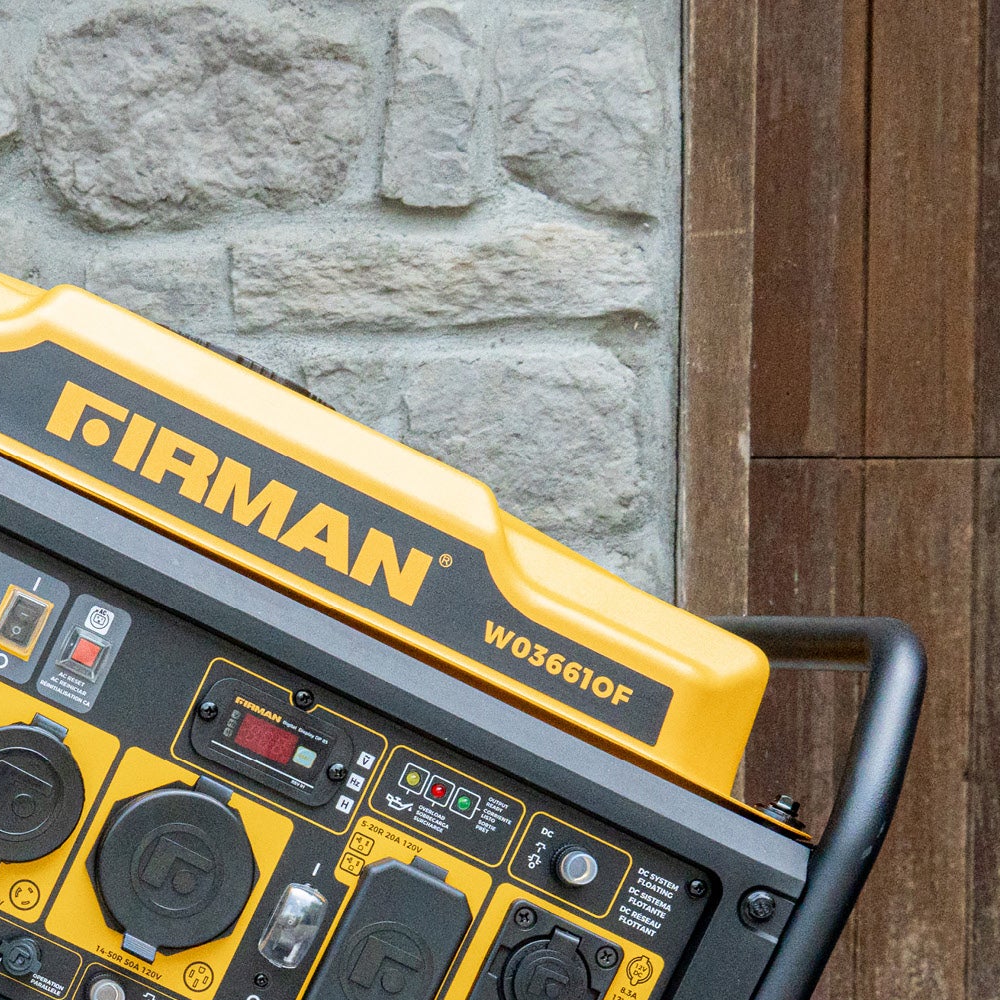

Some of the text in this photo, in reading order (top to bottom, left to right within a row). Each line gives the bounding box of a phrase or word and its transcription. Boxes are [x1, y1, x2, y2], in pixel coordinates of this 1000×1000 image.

[45, 380, 434, 607] FIRMAN
[50, 676, 59, 684] AC
[58, 671, 86, 687] AC RESET
[234, 696, 282, 724] FIRMAN
[350, 777, 360, 787] Hz
[341, 800, 349, 809] H
[486, 802, 503, 813] READY
[488, 797, 509, 809] OUTPUT
[415, 810, 449, 830] SOBRECARGA
[418, 804, 446, 821] OVERLOAD
[481, 814, 496, 824] LISTO
[483, 808, 513, 826] CORRIENTE
[413, 816, 444, 833] SURCHARGE
[540, 827, 554, 838] DC
[360, 820, 422, 854] 5-20R 20A 120V
[638, 867, 679, 892] DC SYSTEM
[637, 878, 674, 899] FLOATING
[628, 886, 672, 912] DC SISTEMA
[628, 896, 667, 919] FLOTANTE
[618, 914, 657, 937] FLOTTANT
[619, 905, 662, 930] DC RÉSEAU
[95, 945, 163, 981] 14-50R 50A 120V
[635, 963, 647, 973] 12V
[32, 973, 65, 990] OPERATION
[633, 970, 643, 978] DC
[620, 987, 637, 1000] 8.3A
